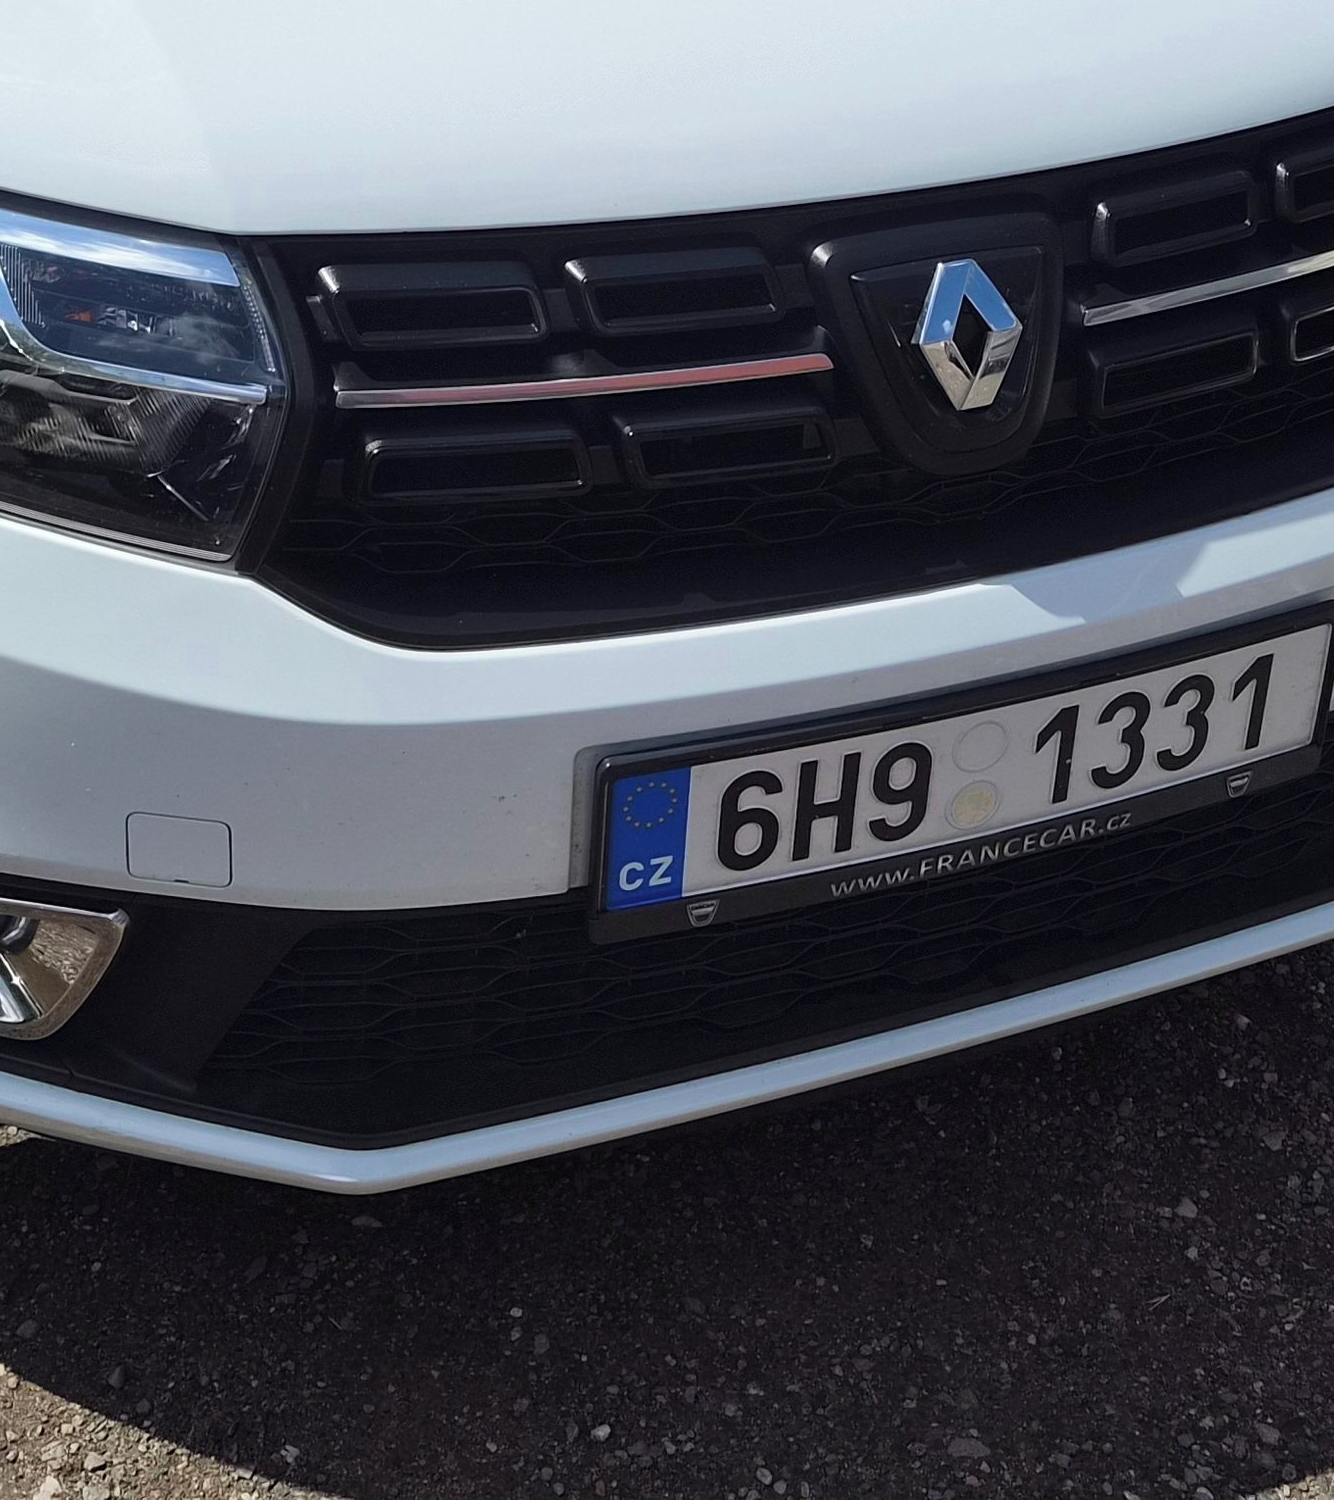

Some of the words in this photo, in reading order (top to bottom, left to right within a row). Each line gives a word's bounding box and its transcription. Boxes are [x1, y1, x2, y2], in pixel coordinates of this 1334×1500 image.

[717, 741, 933, 872] 6H9
[1034, 653, 1274, 805] 1331
[618, 855, 674, 892] CZ
[830, 811, 1132, 898] www.FRANCECAR.cz
